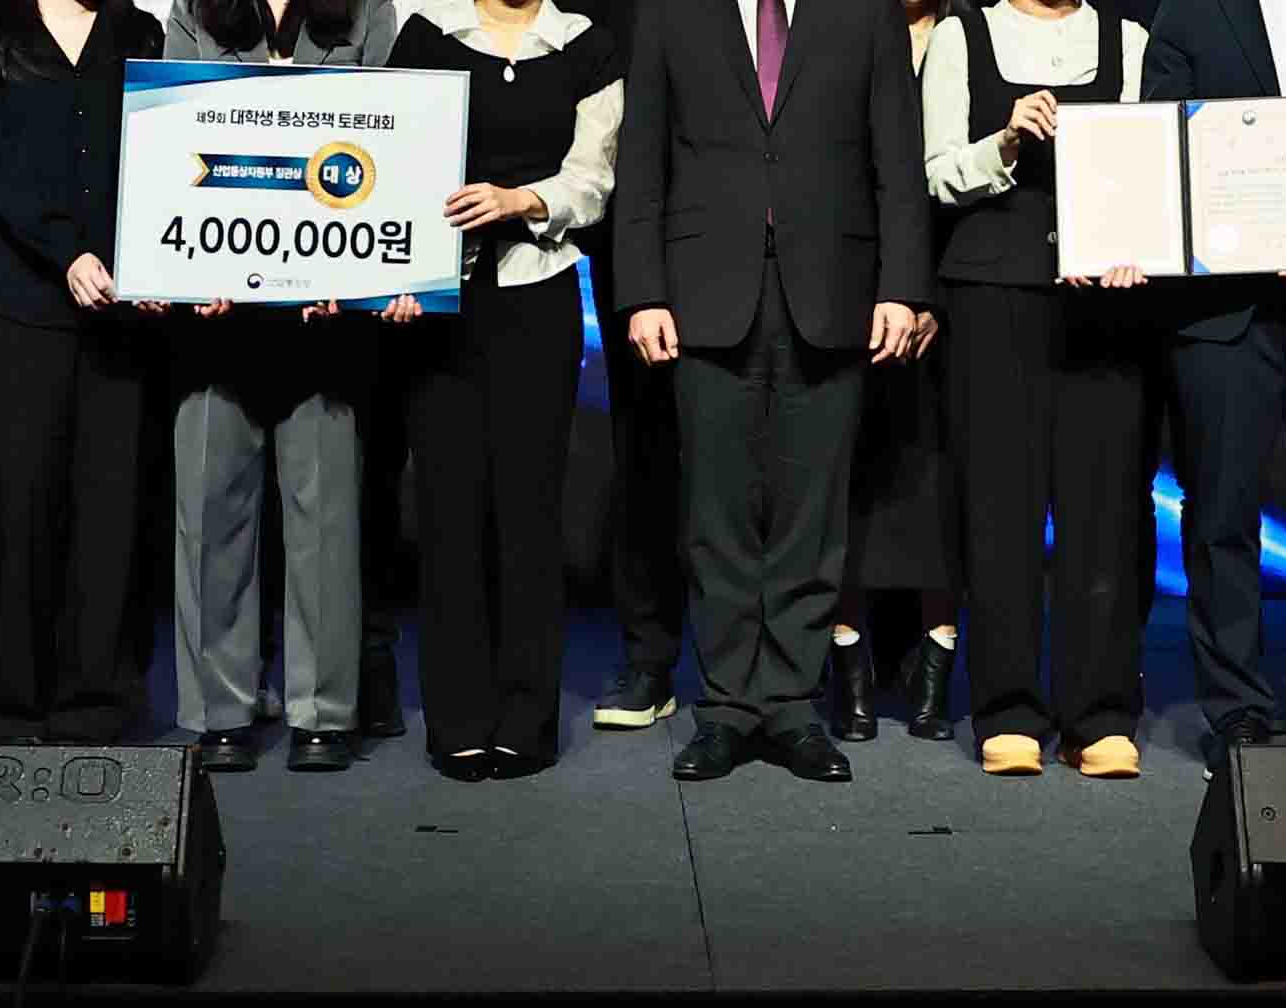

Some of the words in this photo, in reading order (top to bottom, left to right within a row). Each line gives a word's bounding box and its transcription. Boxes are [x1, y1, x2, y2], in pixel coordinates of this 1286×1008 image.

[196, 109, 226, 124] 제9회
[230, 109, 274, 126] 대학생
[277, 111, 334, 129] 통상정책
[337, 114, 395, 130] 토론대회
[161, 216, 413, 264] 4,000,000원
